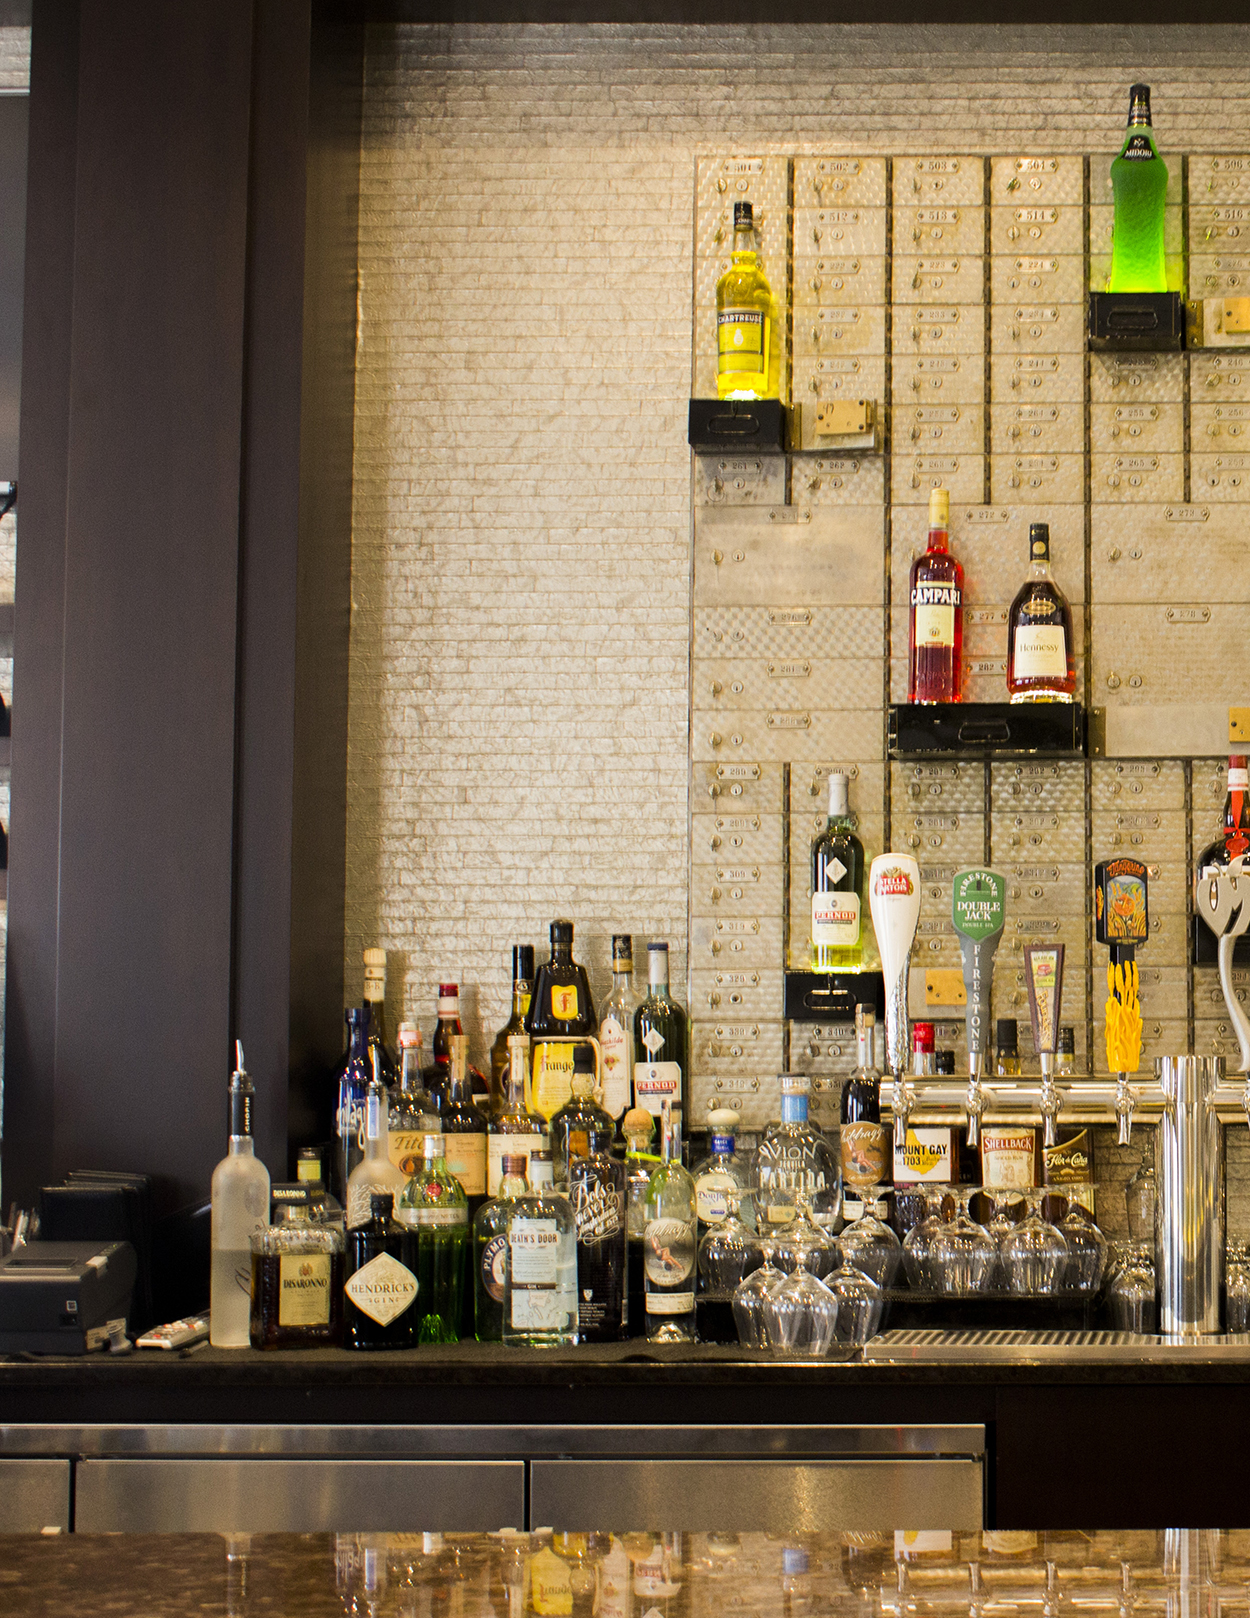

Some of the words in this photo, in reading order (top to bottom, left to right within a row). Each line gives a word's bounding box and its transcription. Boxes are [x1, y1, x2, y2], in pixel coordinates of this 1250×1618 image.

[1124, 148, 1153, 158] MIDORI
[734, 163, 751, 172] 501
[830, 162, 848, 171] 502
[929, 162, 946, 170] 503
[1027, 161, 1045, 169] 504
[1225, 161, 1243, 169] 506
[829, 213, 847, 221] 512
[929, 211, 947, 219] 513
[1027, 211, 1045, 219] 514
[1225, 209, 1243, 218] 516
[717, 312, 764, 324] CHARTREUSE
[910, 588, 961, 605] CAMPARI
[1019, 642, 1060, 653] Hennessy
[880, 877, 907, 885] STELLA
[959, 872, 998, 898] FIRESTONE
[880, 884, 908, 893] ARTOIS
[957, 902, 1000, 912] DOUBLE
[815, 910, 856, 920] PERNOD
[964, 911, 991, 921] JACK
[972, 944, 982, 1051] FIRESTONE
[540, 1056, 574, 1073] Frange
[984, 1137, 1032, 1151] SHELLBACK
[895, 1144, 926, 1155] MOUNT
[929, 1144, 948, 1155] GAY
[902, 1157, 921, 1166] 1703
[1046, 1153, 1064, 1167] Flor
[1071, 1152, 1088, 1167] Caña
[273, 1189, 307, 1199] DISARONNO
[511, 1234, 535, 1243] DEATH'S
[537, 1233, 558, 1243] DOOR
[484, 1237, 506, 1270] PLYMO
[283, 1278, 328, 1289] DISARONNO
[351, 1283, 415, 1294] HENDRICK'S
